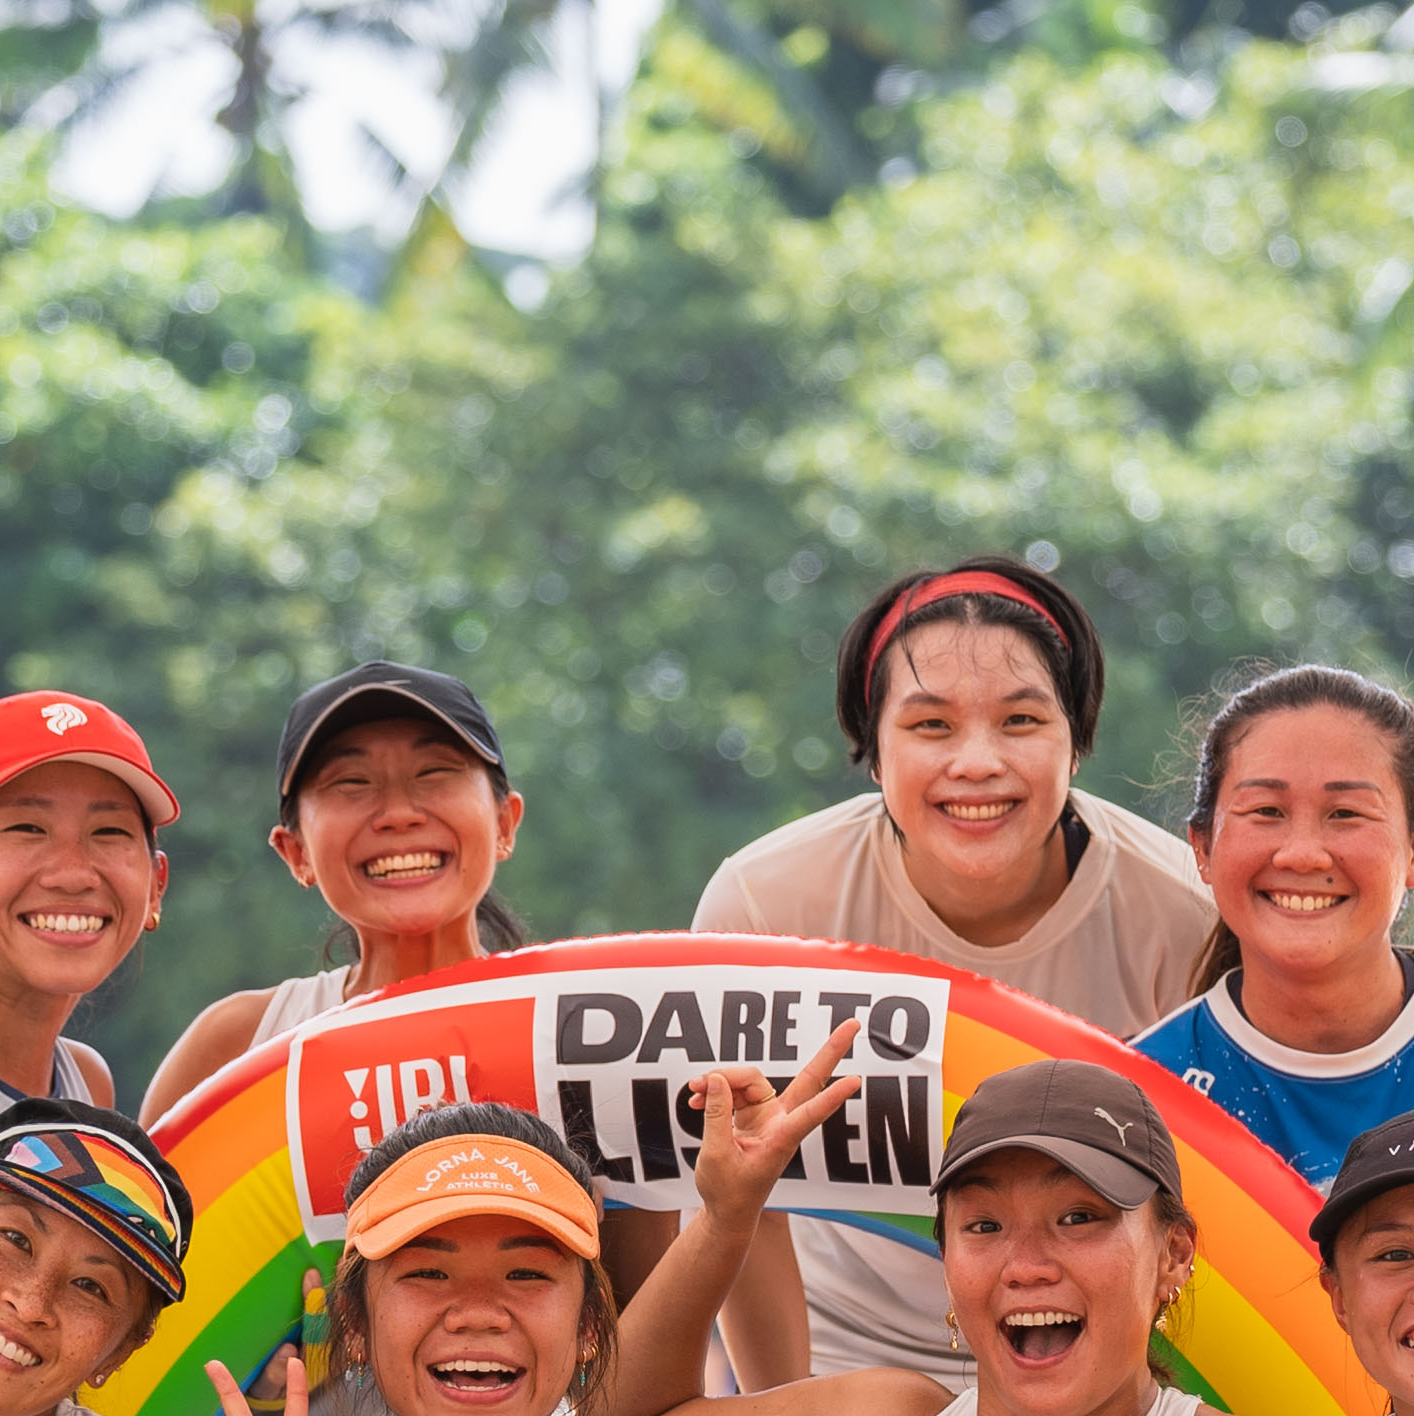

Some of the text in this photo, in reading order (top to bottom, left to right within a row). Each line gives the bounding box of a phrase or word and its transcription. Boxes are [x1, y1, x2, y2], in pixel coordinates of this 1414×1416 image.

[556, 990, 931, 1065] DARE TO
[416, 1148, 540, 1193] LORNA JANE
[461, 1172, 499, 1181] LUXE
[446, 1181, 515, 1192] ATHLETIC
